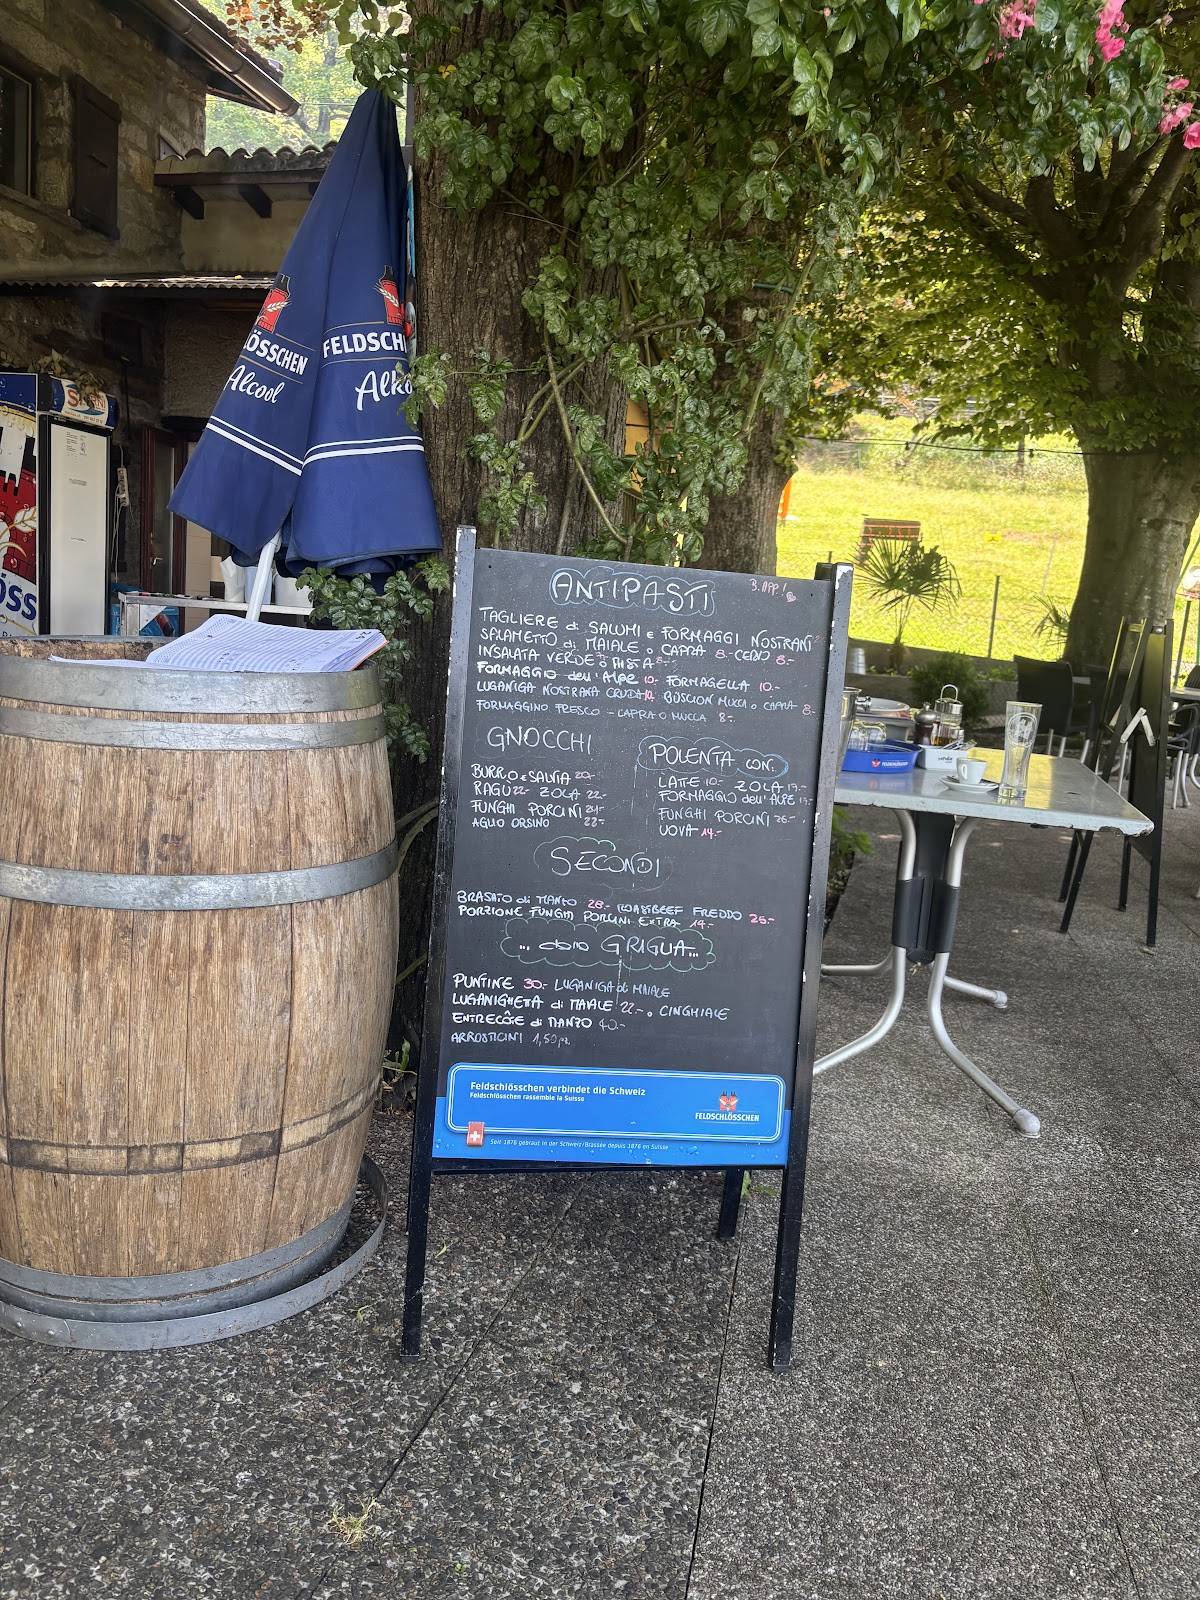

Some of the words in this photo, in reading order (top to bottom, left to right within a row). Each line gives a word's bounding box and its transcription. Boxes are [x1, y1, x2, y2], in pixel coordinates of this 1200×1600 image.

[322, 331, 408, 359] FELDSCH
[223, 364, 286, 404] Alcool
[552, 572, 708, 612] ANTIPASTI
[479, 606, 559, 629] TAGLIERE
[566, 621, 580, 631] di
[588, 620, 641, 638] SALUMI
[661, 626, 739, 646] FORMAGGI
[751, 629, 813, 653] NOSTRANI
[480, 626, 558, 647] SALAMETTO
[563, 639, 577, 649] di
[586, 636, 640, 653] MAIALE
[661, 643, 707, 657] CAPRA
[478, 644, 541, 662] INSALATA
[547, 650, 595, 666] VERDE
[477, 661, 557, 681] FORMAGGIO
[665, 674, 751, 692] FORMAGELLA
[759, 681, 781, 692] 10.-
[476, 680, 537, 695] LUGANIGA
[542, 683, 600, 698] NOSTRANA
[606, 687, 645, 700] CRUDA
[717, 697, 747, 709] MUCCA
[763, 701, 799, 711] CAPRA
[476, 699, 549, 714] FORMAGGINO
[555, 702, 600, 716] FRESCO
[617, 708, 656, 720] CAPRA
[671, 710, 707, 722] MUCCA
[487, 725, 592, 755] GNOCCHI
[649, 742, 736, 769] POLENTA
[471, 763, 519, 782] BURRO
[528, 769, 572, 786] SALVIA
[658, 775, 701, 789] LATTE
[735, 780, 785, 794] ZOLA
[539, 786, 581, 801] ZOLA
[658, 788, 737, 804] FORMAGGIO
[471, 799, 516, 815] FUNGHI
[527, 801, 583, 819] PORCINI
[658, 805, 707, 821] FUNGHI
[714, 809, 770, 828] PORCINI
[511, 816, 550, 829] ORSINO
[659, 823, 699, 837] UOVA
[551, 845, 660, 877] SECONDI
[457, 889, 513, 904] BRASATO
[516, 895, 531, 904] di
[692, 905, 743, 921] FREDDO
[458, 904, 523, 918] PORZIONE
[583, 910, 632, 925] PORCINI
[452, 972, 515, 991] PUNTINE
[554, 977, 616, 993] LUGANIGA
[632, 983, 671, 999] MAIALE
[452, 992, 545, 1010] LUGANIGHETTA
[550, 1000, 564, 1010] di
[569, 998, 614, 1012] MAIALE
[659, 1005, 731, 1021] CINGHIALE
[452, 1009, 525, 1027] ENTRECÔTE
[530, 1018, 543, 1028] di
[547, 1015, 593, 1029] MANZO
[451, 1030, 523, 1044] ARROSTICINI
[469, 1091, 522, 1101] Feldschlösschen
[522, 1093, 555, 1101] rassemble
[556, 1094, 563, 1102] la
[564, 1095, 585, 1103] Suisse
[470, 1081, 544, 1094] Feldschlösschen
[546, 1084, 590, 1095] verbindet
[593, 1085, 607, 1095] die
[609, 1086, 646, 1097] Schweiz
[695, 1111, 760, 1123] FELDSCHLÖSSCHEN
